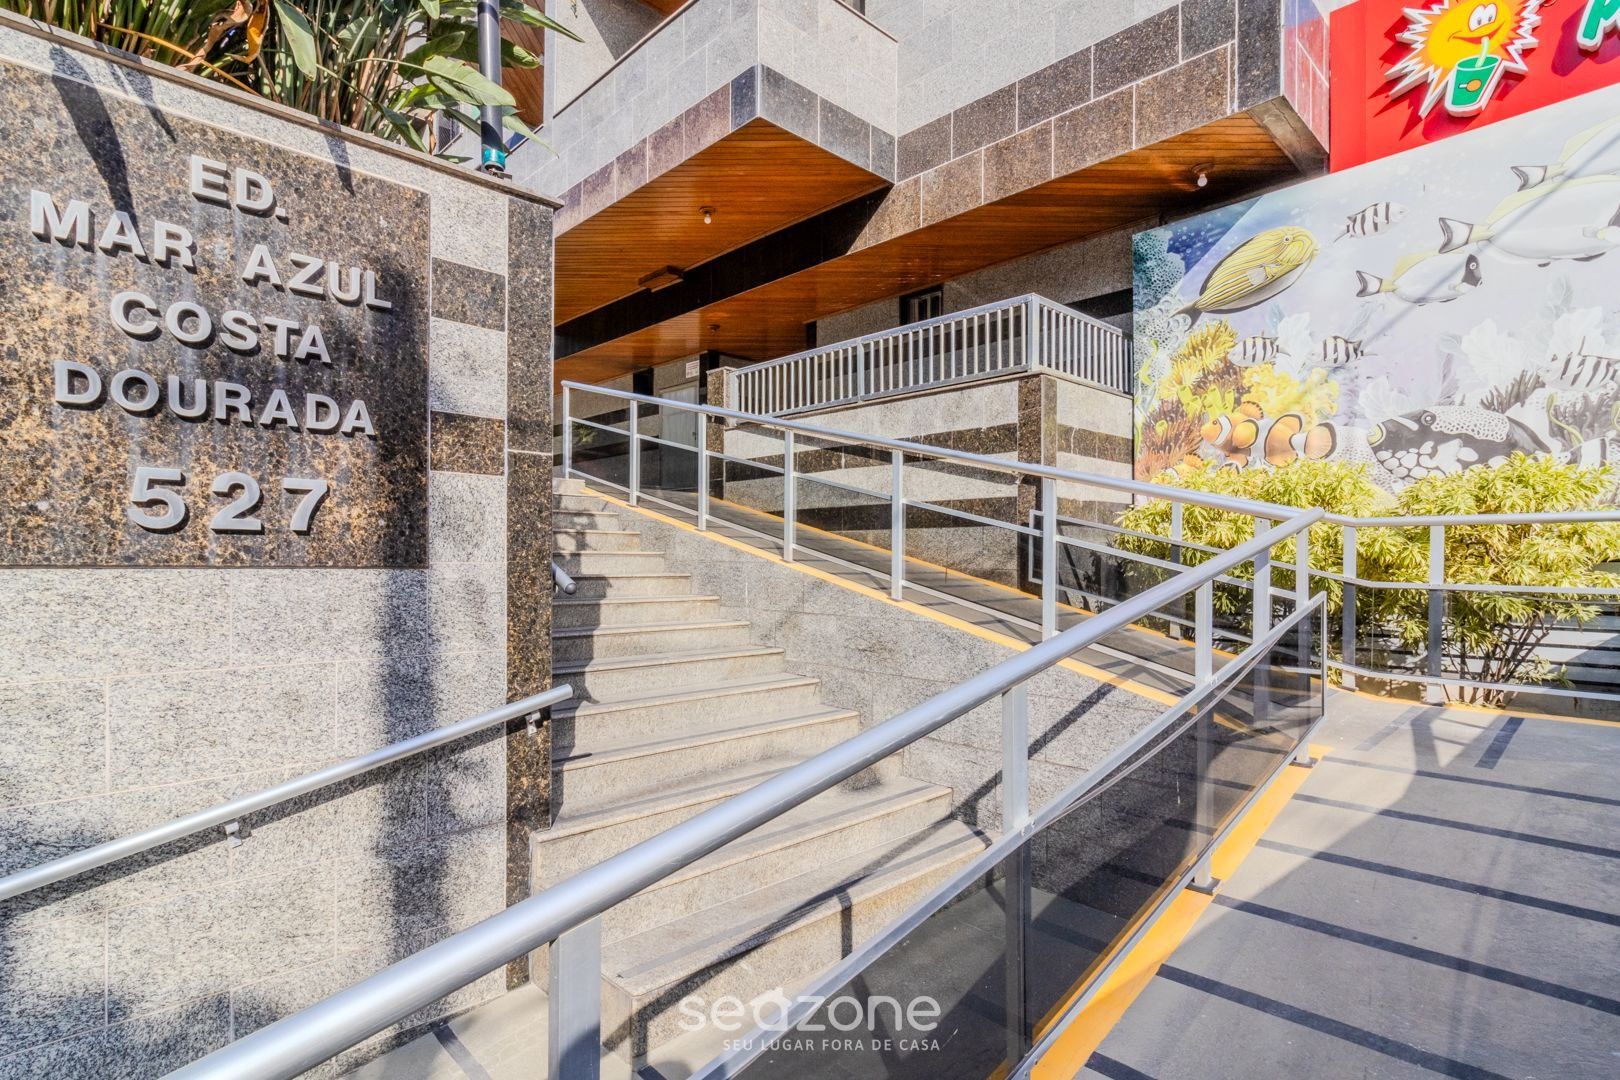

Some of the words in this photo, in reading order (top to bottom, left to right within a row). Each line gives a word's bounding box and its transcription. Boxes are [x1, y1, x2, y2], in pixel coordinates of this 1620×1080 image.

[190, 154, 289, 220] ED.
[30, 189, 197, 270] MAR
[242, 243, 393, 310] AZUL
[110, 290, 333, 364] COSTA
[53, 359, 377, 438] DOURADA
[127, 466, 329, 534] 527
